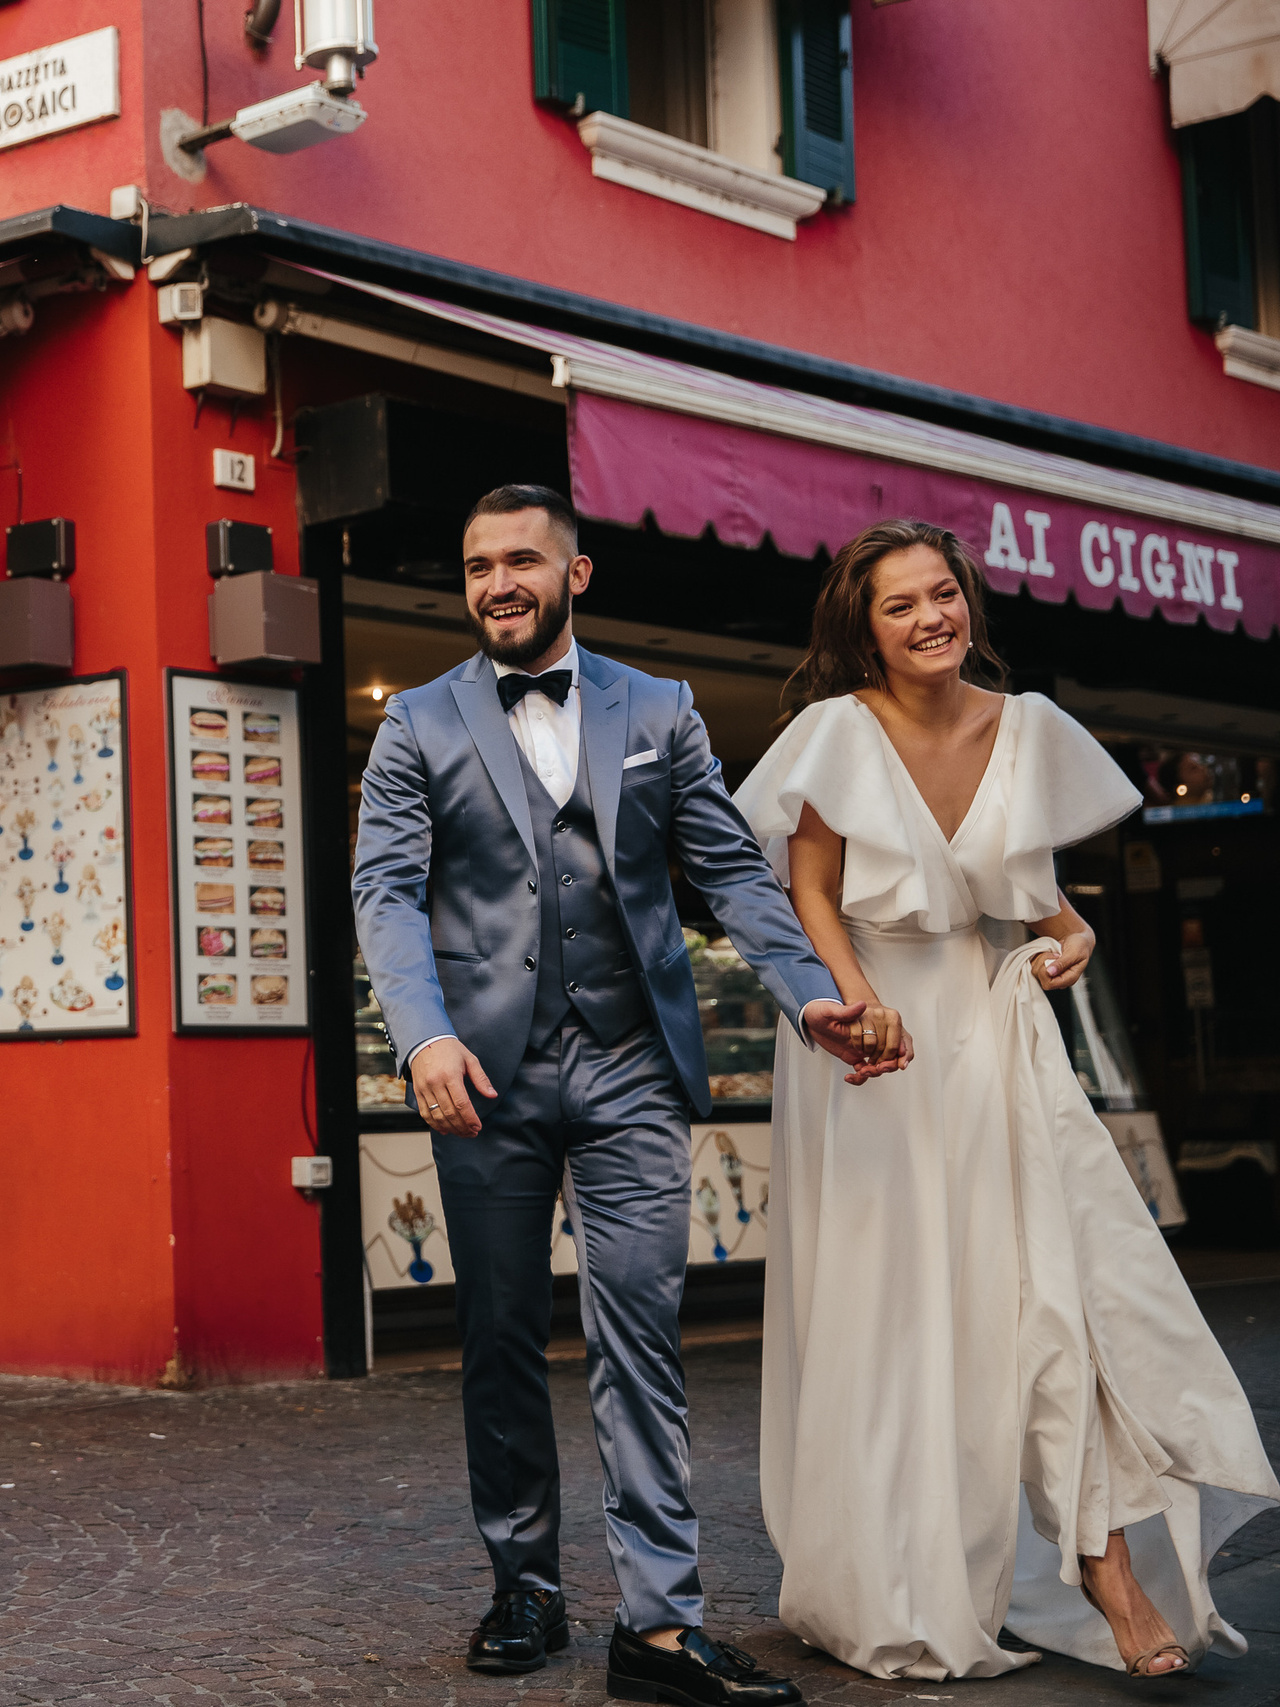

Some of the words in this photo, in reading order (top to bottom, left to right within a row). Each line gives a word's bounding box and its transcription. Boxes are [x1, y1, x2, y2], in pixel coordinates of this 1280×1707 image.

[230, 459, 245, 482] 12
[984, 502, 1055, 578] AI
[1080, 521, 1243, 612] CIGNI
